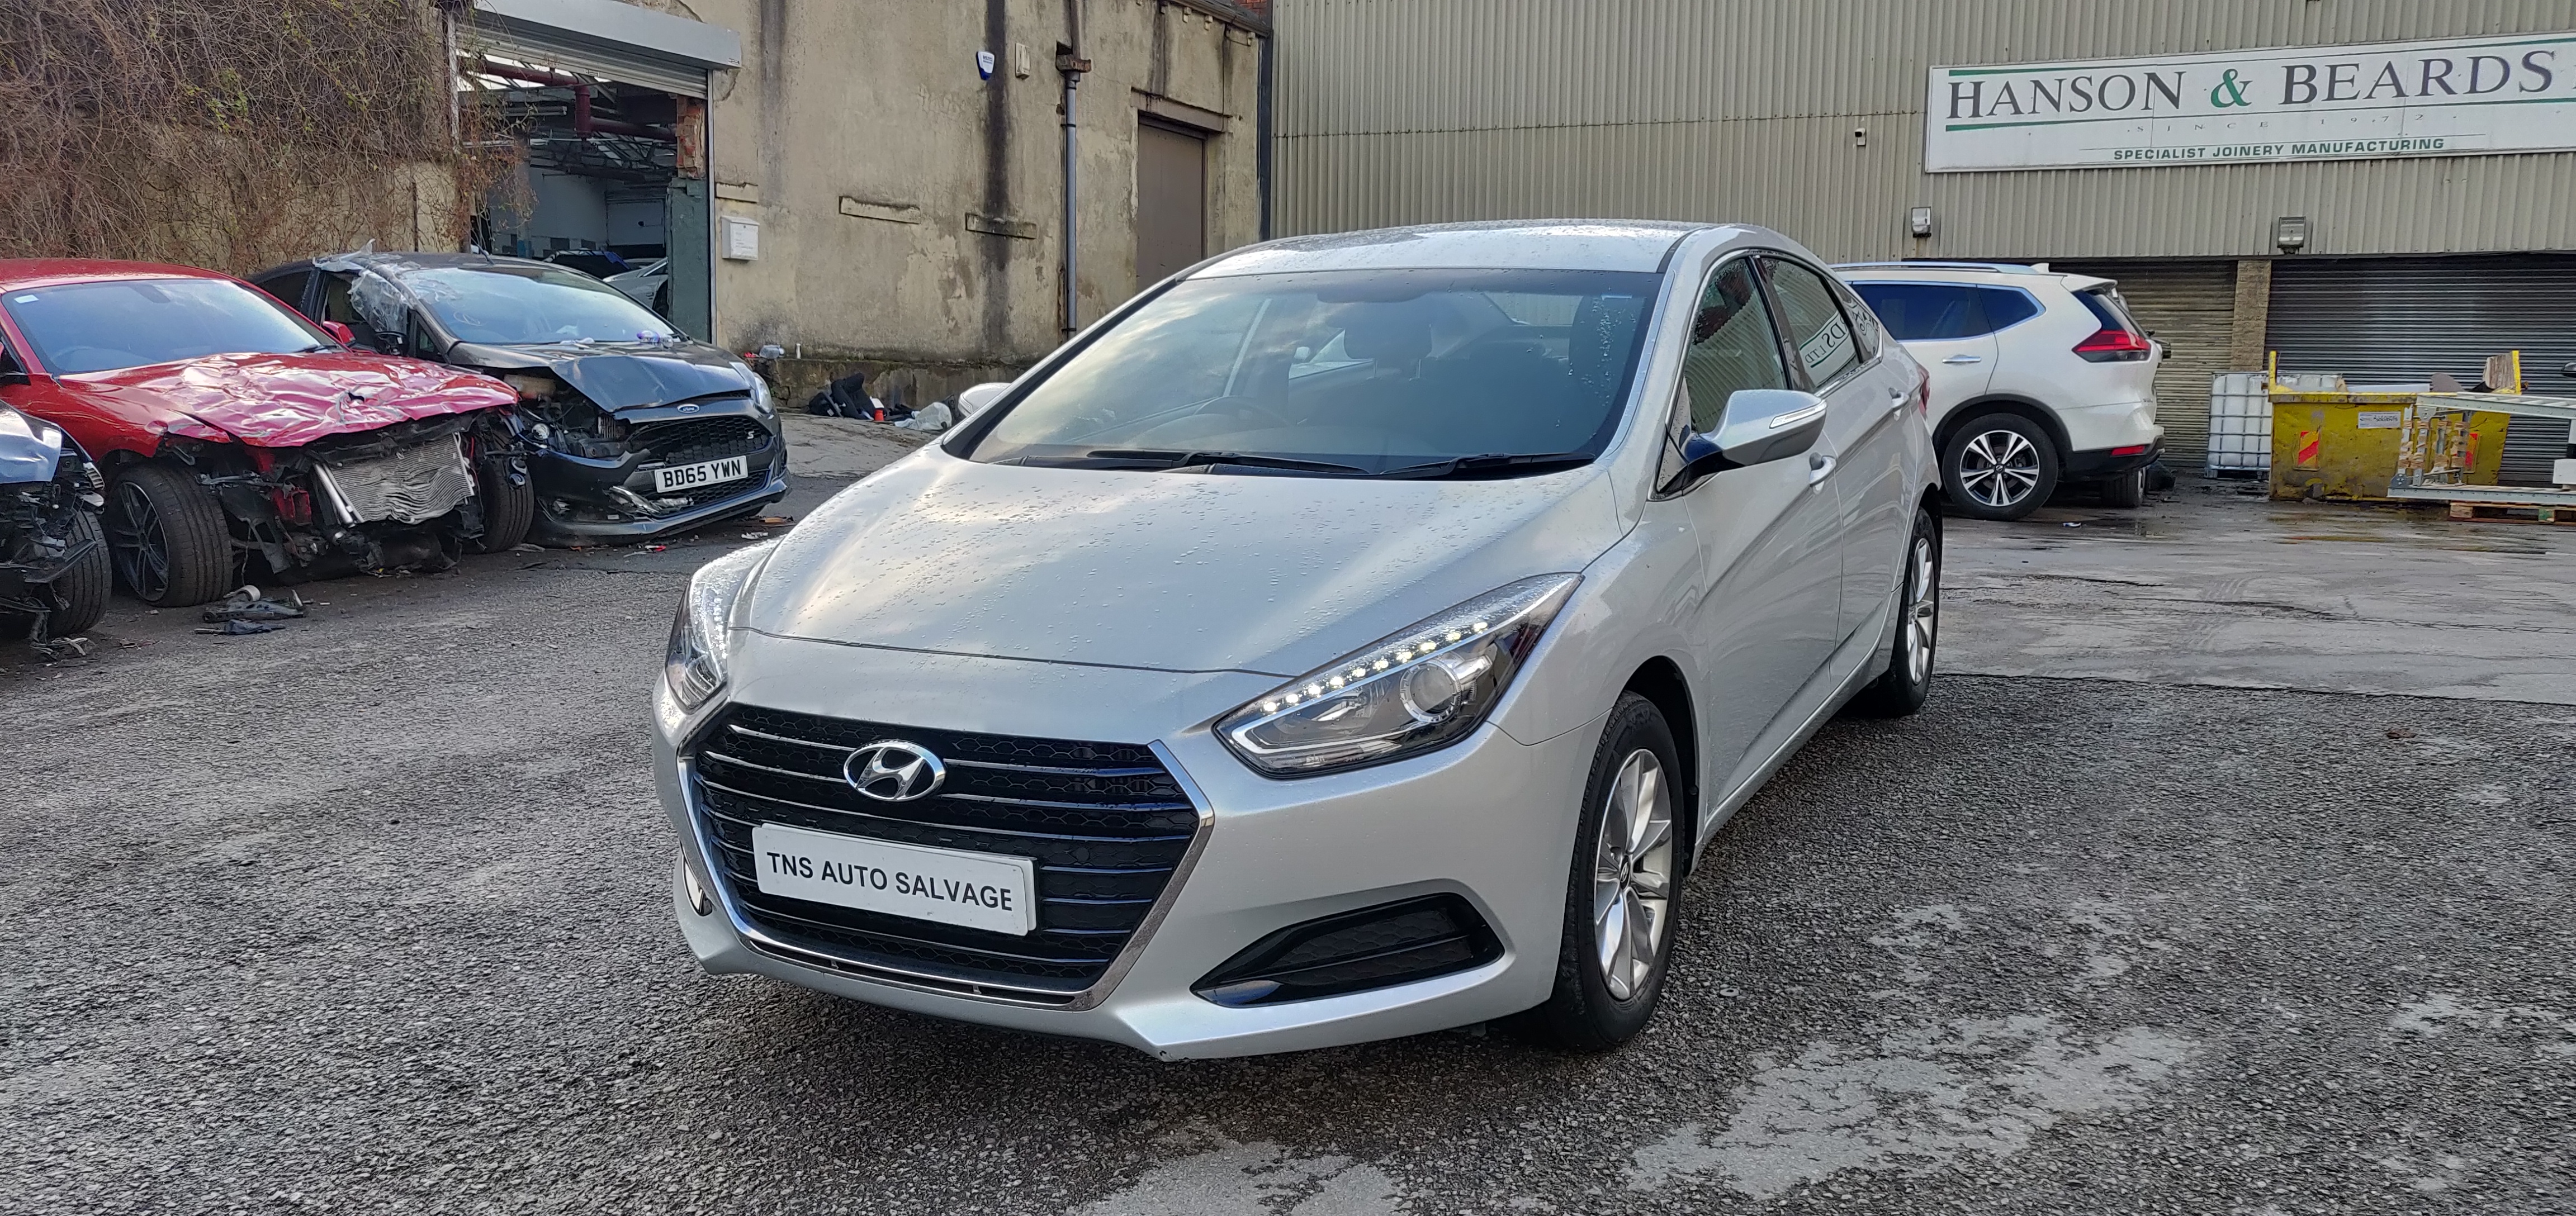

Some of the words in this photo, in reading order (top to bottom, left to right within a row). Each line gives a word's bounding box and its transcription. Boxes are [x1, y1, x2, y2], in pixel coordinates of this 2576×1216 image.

[1947, 72, 2186, 119] HANSON
[2210, 69, 2253, 108] &
[2278, 50, 2556, 105] BEARDS
[2137, 121, 2268, 132] SINCE
[2321, 114, 2423, 125] 1972
[2114, 148, 2206, 160] SPECIALIST
[2213, 144, 2284, 157] JOINERY
[2292, 138, 2445, 154] MANUFACTURING
[662, 465, 707, 488] BD65
[711, 459, 741, 479] YWN
[766, 852, 813, 878] TNS
[821, 861, 888, 890] AUTO
[895, 872, 1012, 911] SALVAGE
